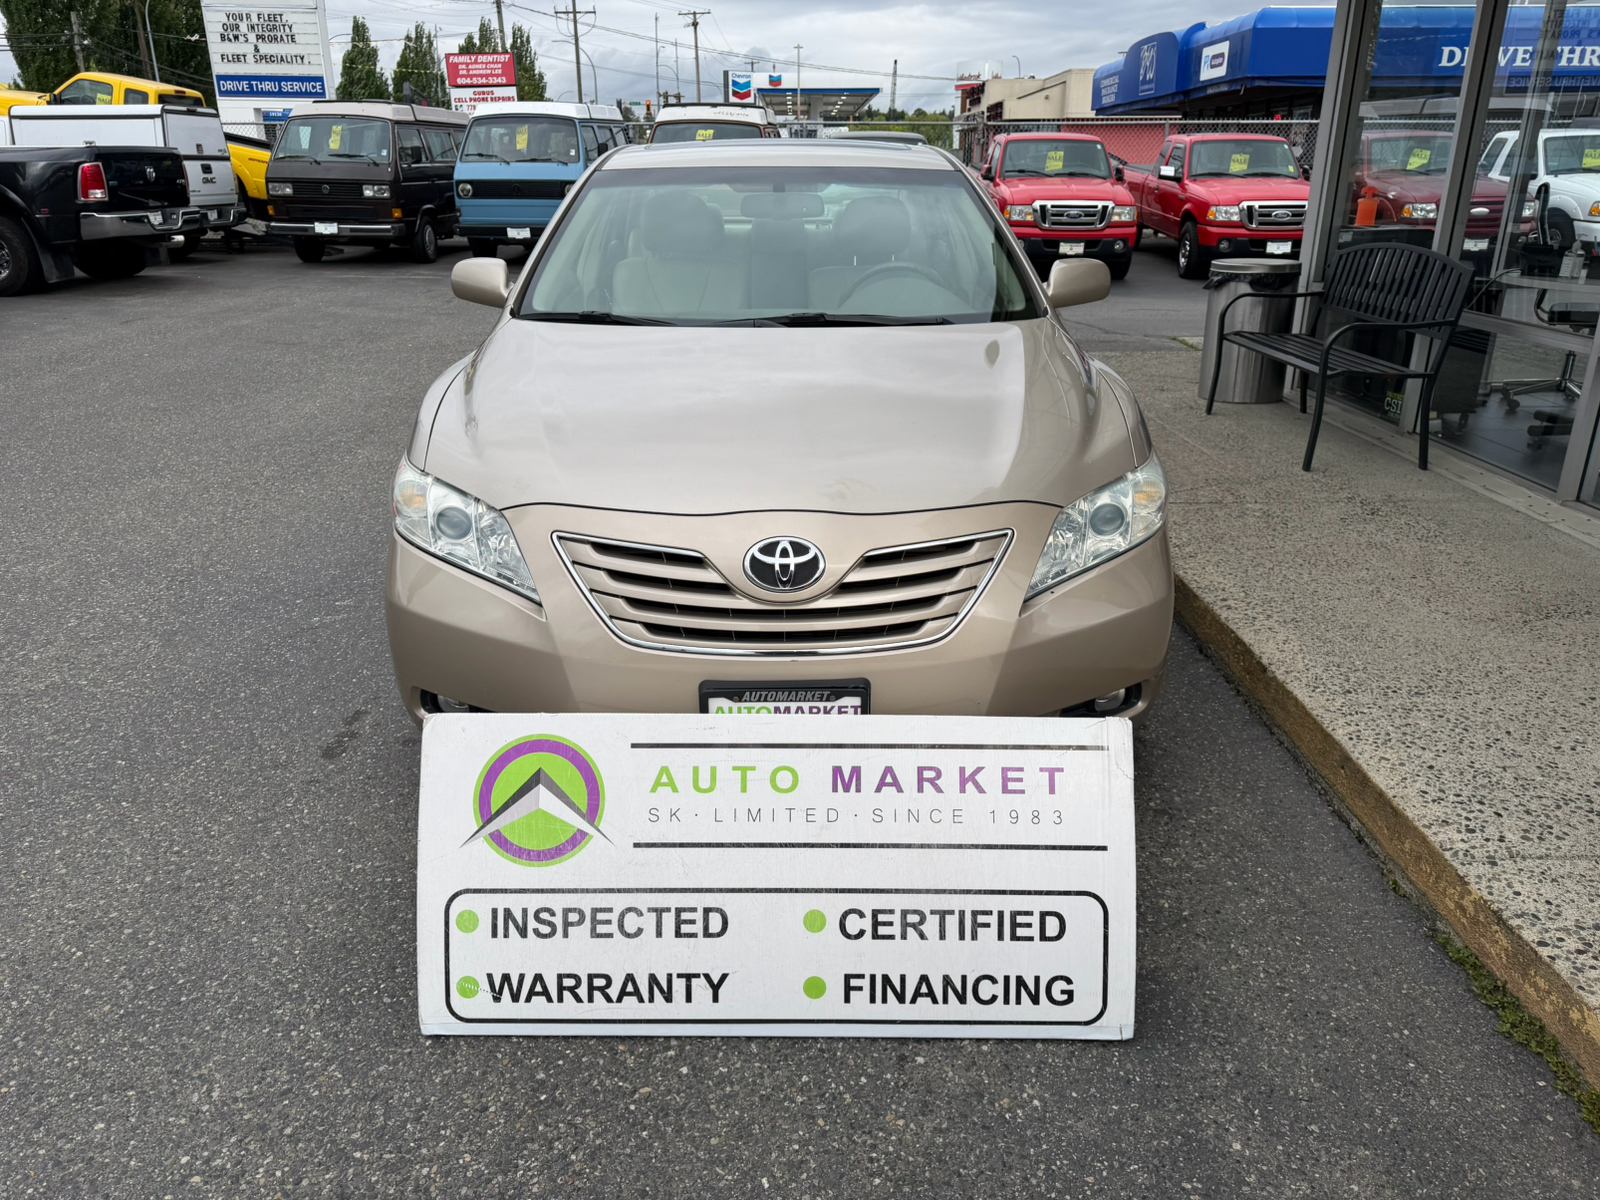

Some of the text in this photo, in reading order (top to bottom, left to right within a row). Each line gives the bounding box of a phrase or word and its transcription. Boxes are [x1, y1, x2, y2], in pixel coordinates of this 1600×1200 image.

[225, 12, 252, 22] YOUR
[222, 23, 293, 33] OUR INTEGRITY
[220, 34, 296, 43] B&W'S PRORATE
[254, 44, 260, 53] &
[220, 54, 247, 63] FLEET
[220, 80, 323, 92] DRIVE THRU SERVICE
[1384, 397, 1402, 414] CSI
[741, 691, 830, 702] AUTOMARKET
[714, 705, 862, 715] AUTOMARKET
[650, 766, 1064, 795] AUTO MARKET
[648, 808, 1063, 825] SK LIMITED SINCE 1983
[490, 906, 728, 940] INSPECTED
[838, 908, 1066, 942] CERTIFIED
[486, 972, 730, 1004] WARRANTY
[844, 974, 1074, 1006] FINANCING
